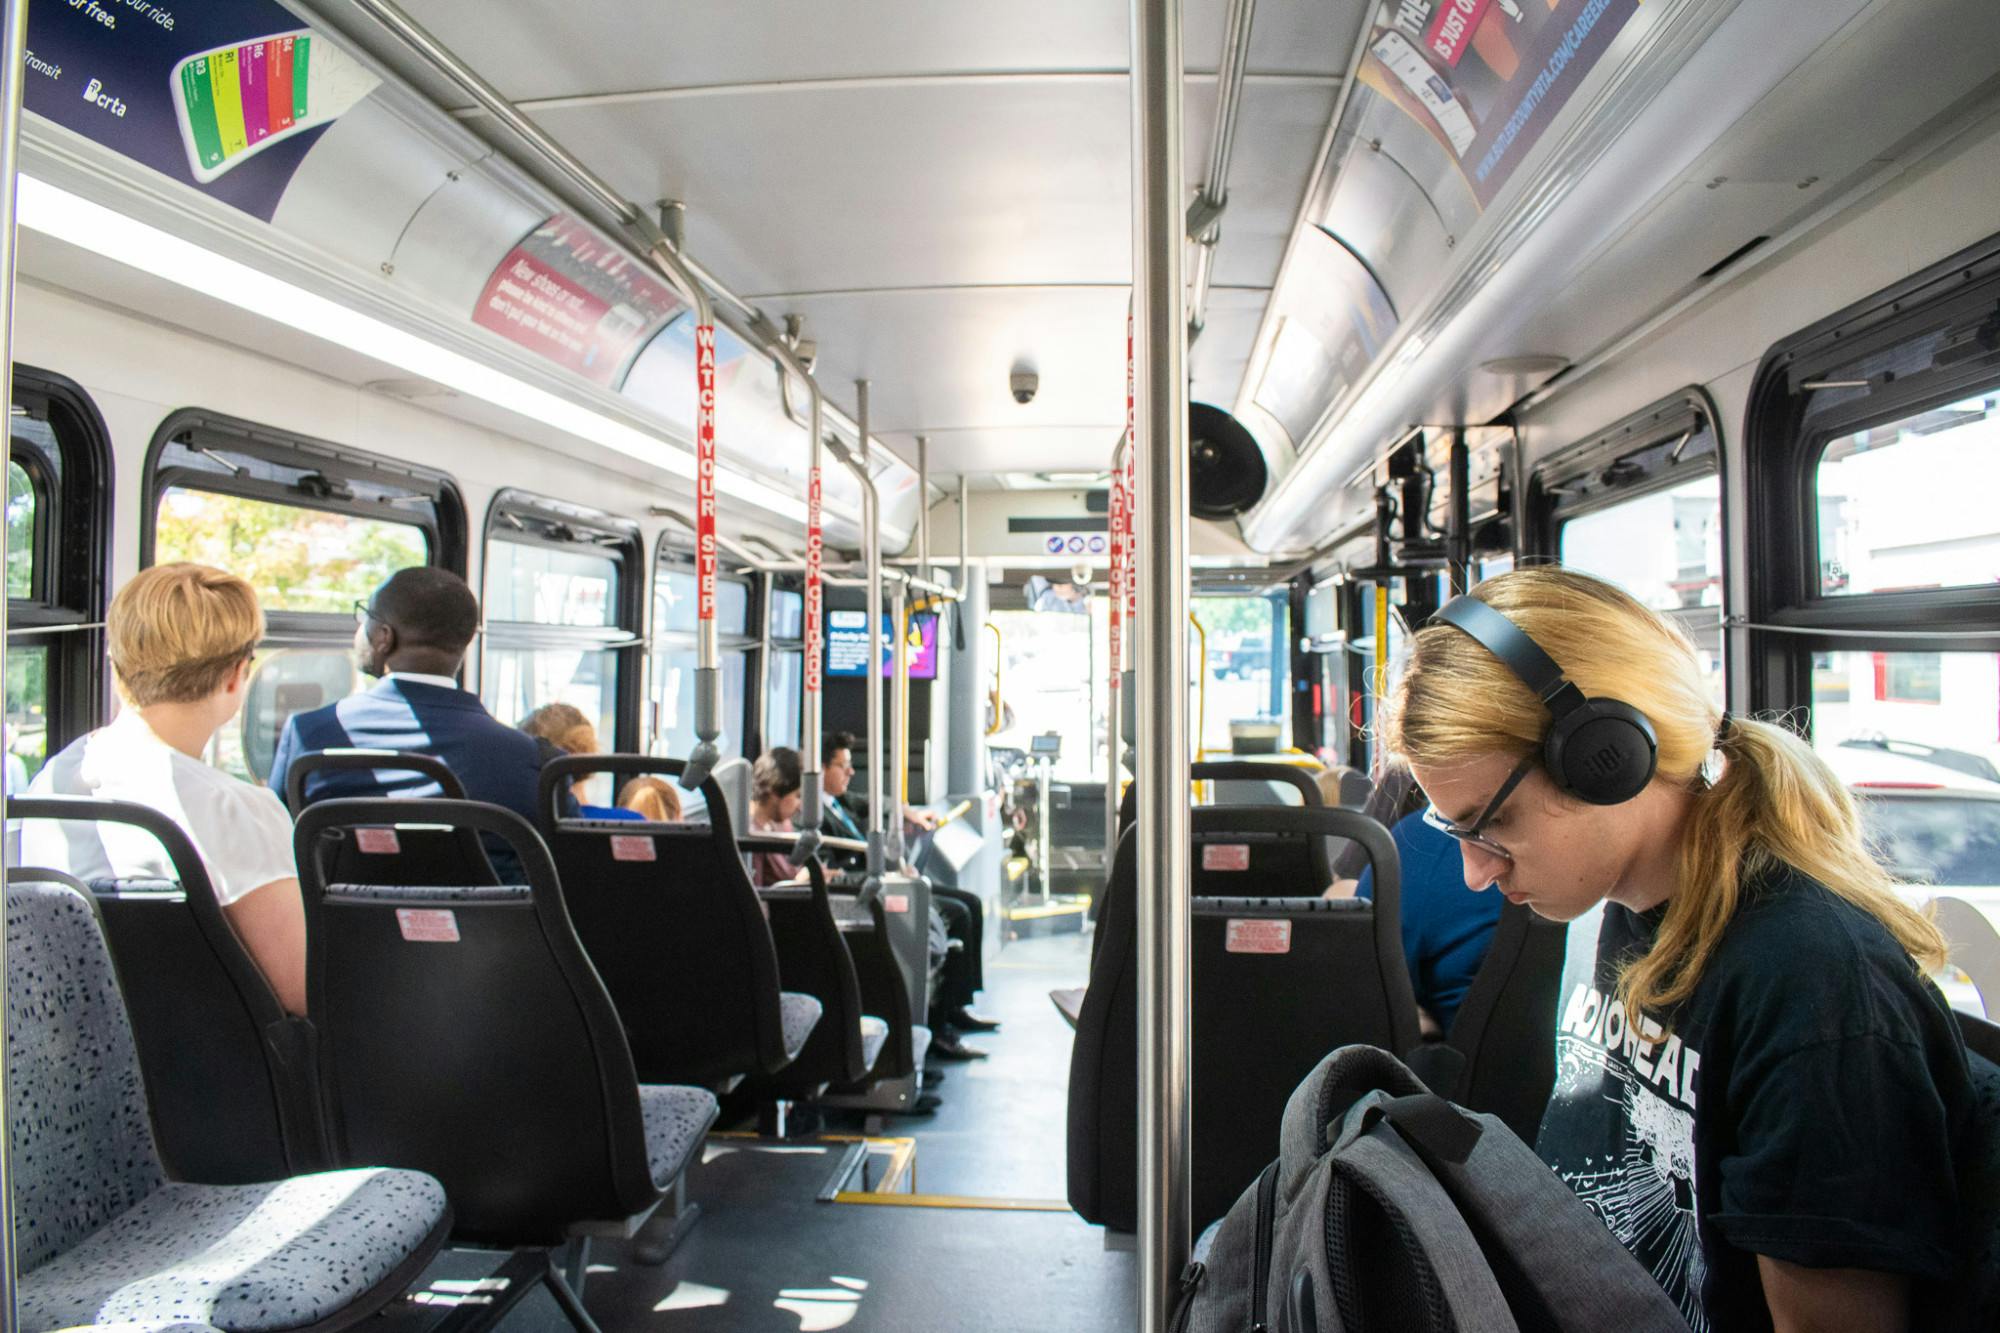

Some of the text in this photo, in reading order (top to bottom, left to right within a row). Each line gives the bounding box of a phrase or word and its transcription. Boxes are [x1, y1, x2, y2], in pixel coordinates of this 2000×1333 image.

[84, 1, 116, 30] free.
[147, 7, 175, 31] ride.
[1440, 6, 1468, 48] JUST
[254, 44, 264, 59] R6
[1433, 38, 1453, 60] IS
[24, 50, 62, 80] Transit
[195, 60, 206, 75] R3
[698, 328, 714, 613] WATCH YOUR STEP
[809, 534, 822, 578] CON
[808, 585, 821, 688] CUIDADO
